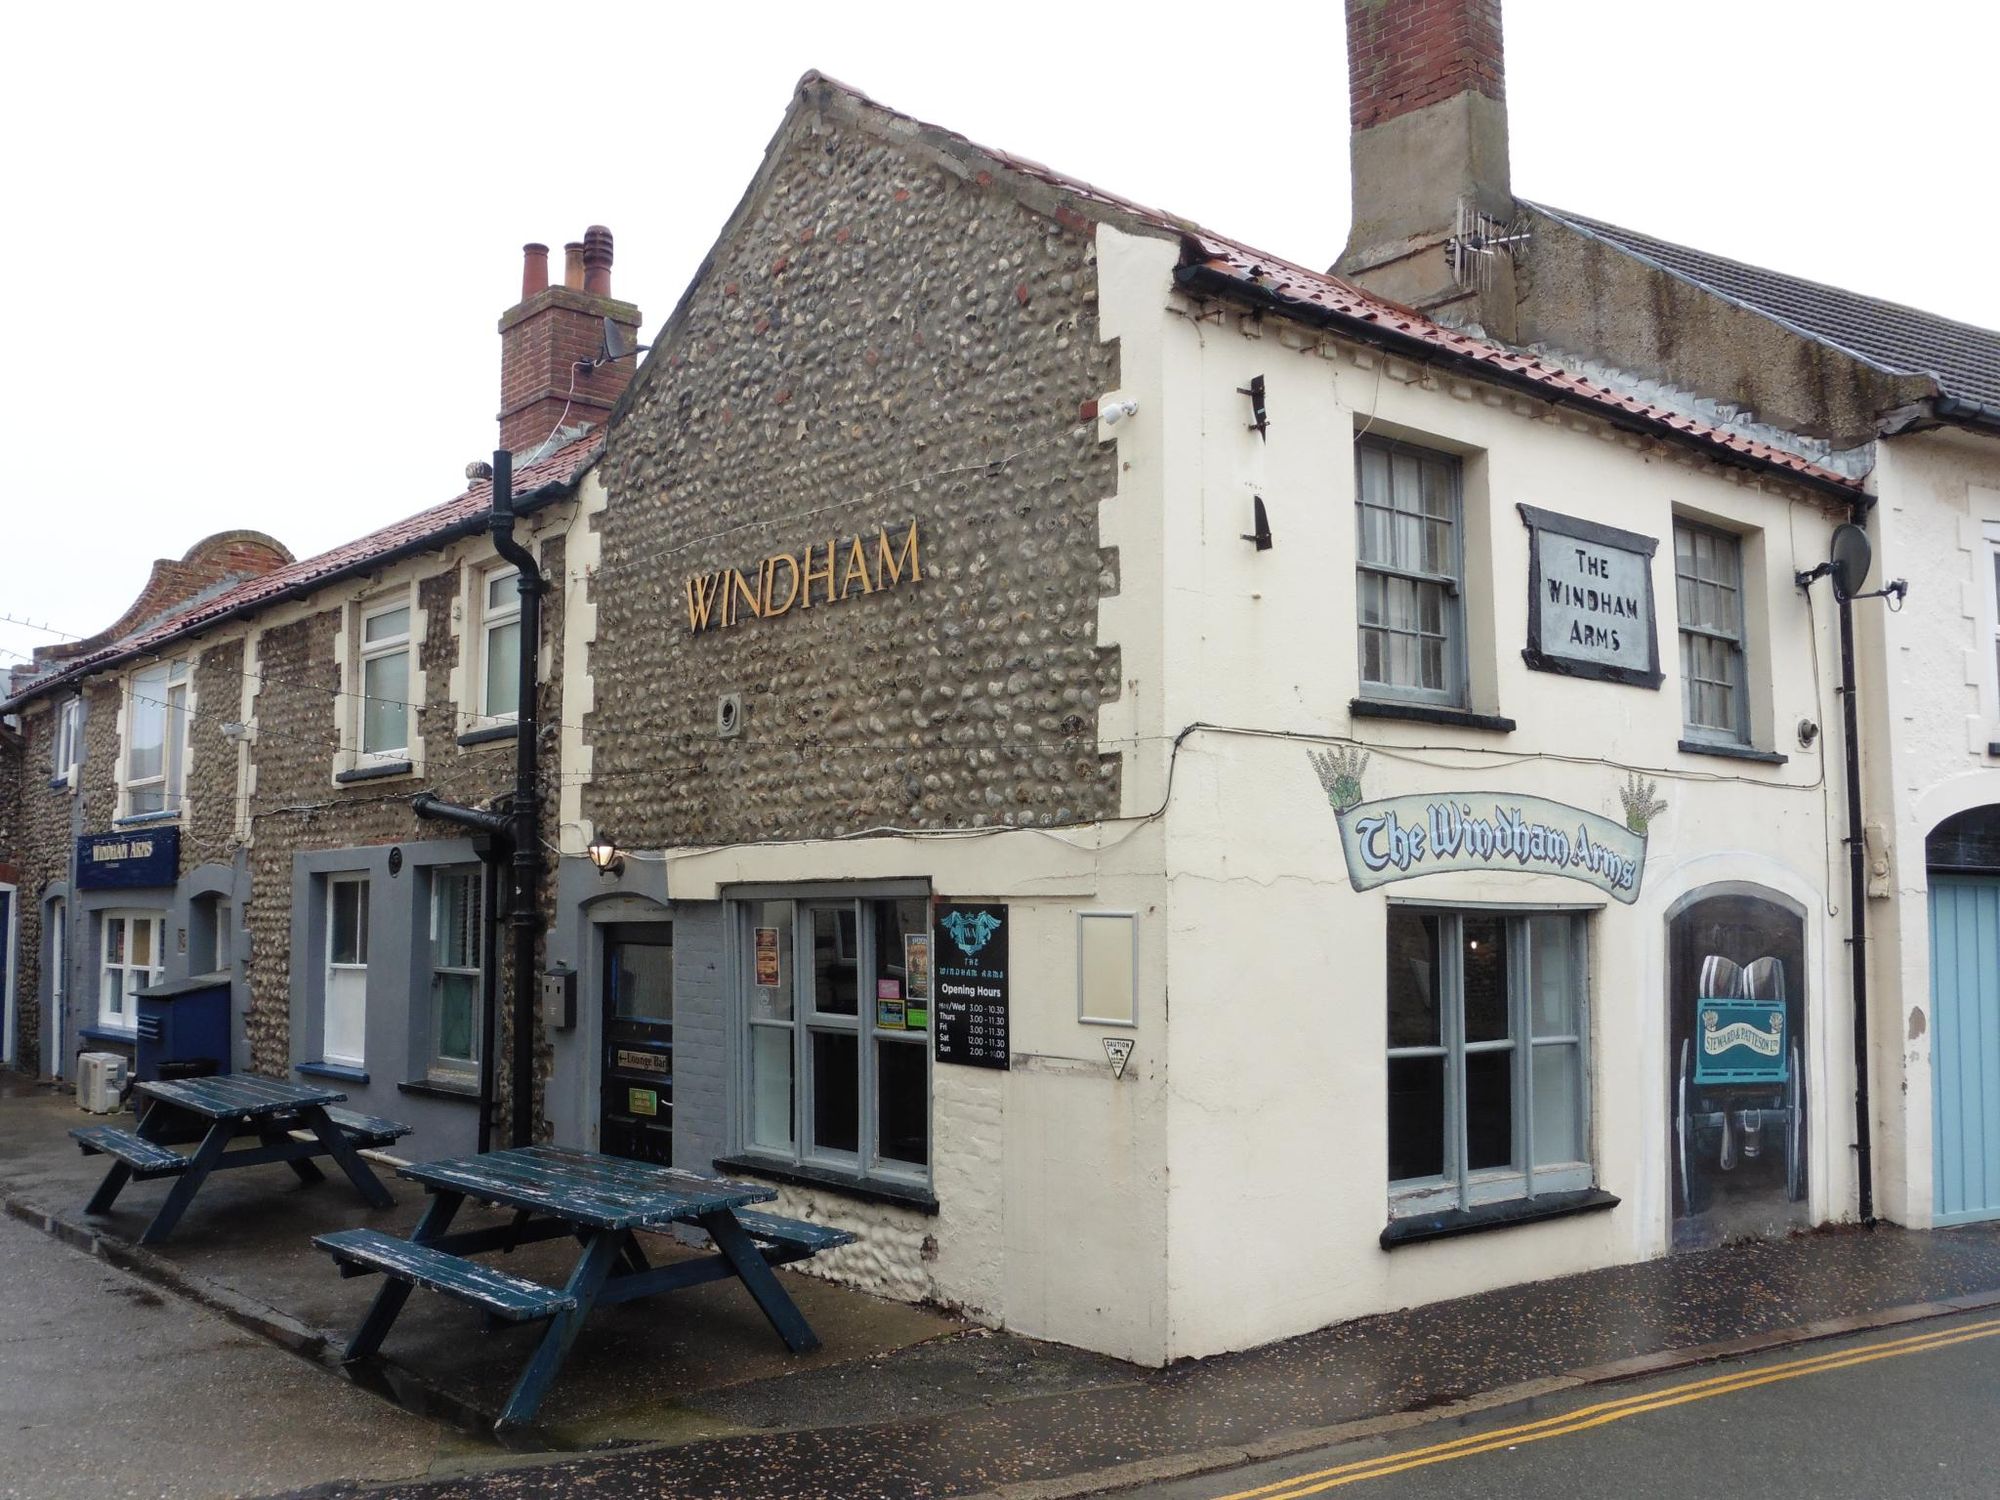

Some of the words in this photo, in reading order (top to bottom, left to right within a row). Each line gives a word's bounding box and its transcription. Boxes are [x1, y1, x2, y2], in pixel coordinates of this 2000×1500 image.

[1575, 549, 1609, 579] THE
[685, 516, 923, 634] WINDHAM
[1547, 578, 1638, 620] WINDHAM
[1569, 619, 1620, 651] ARMS
[1356, 810, 1427, 872] The
[1426, 800, 1570, 869] Windham
[1570, 823, 1637, 890] Arms
[964, 958, 979, 966] THE
[939, 967, 978, 976] WINDHAM
[942, 984, 975, 997] Opening
[977, 986, 1001, 997] Hours
[939, 1012, 955, 1021] Thurs
[939, 1023, 948, 1031] Fri
[939, 1033, 949, 1041] Sat
[1706, 1029, 1736, 1051] STEWARD
[940, 1044, 951, 1052] Sun
[1106, 1041, 1130, 1049] CAUTION
[627, 1052, 652, 1069] Lounge
[653, 1056, 667, 1068] Bar
